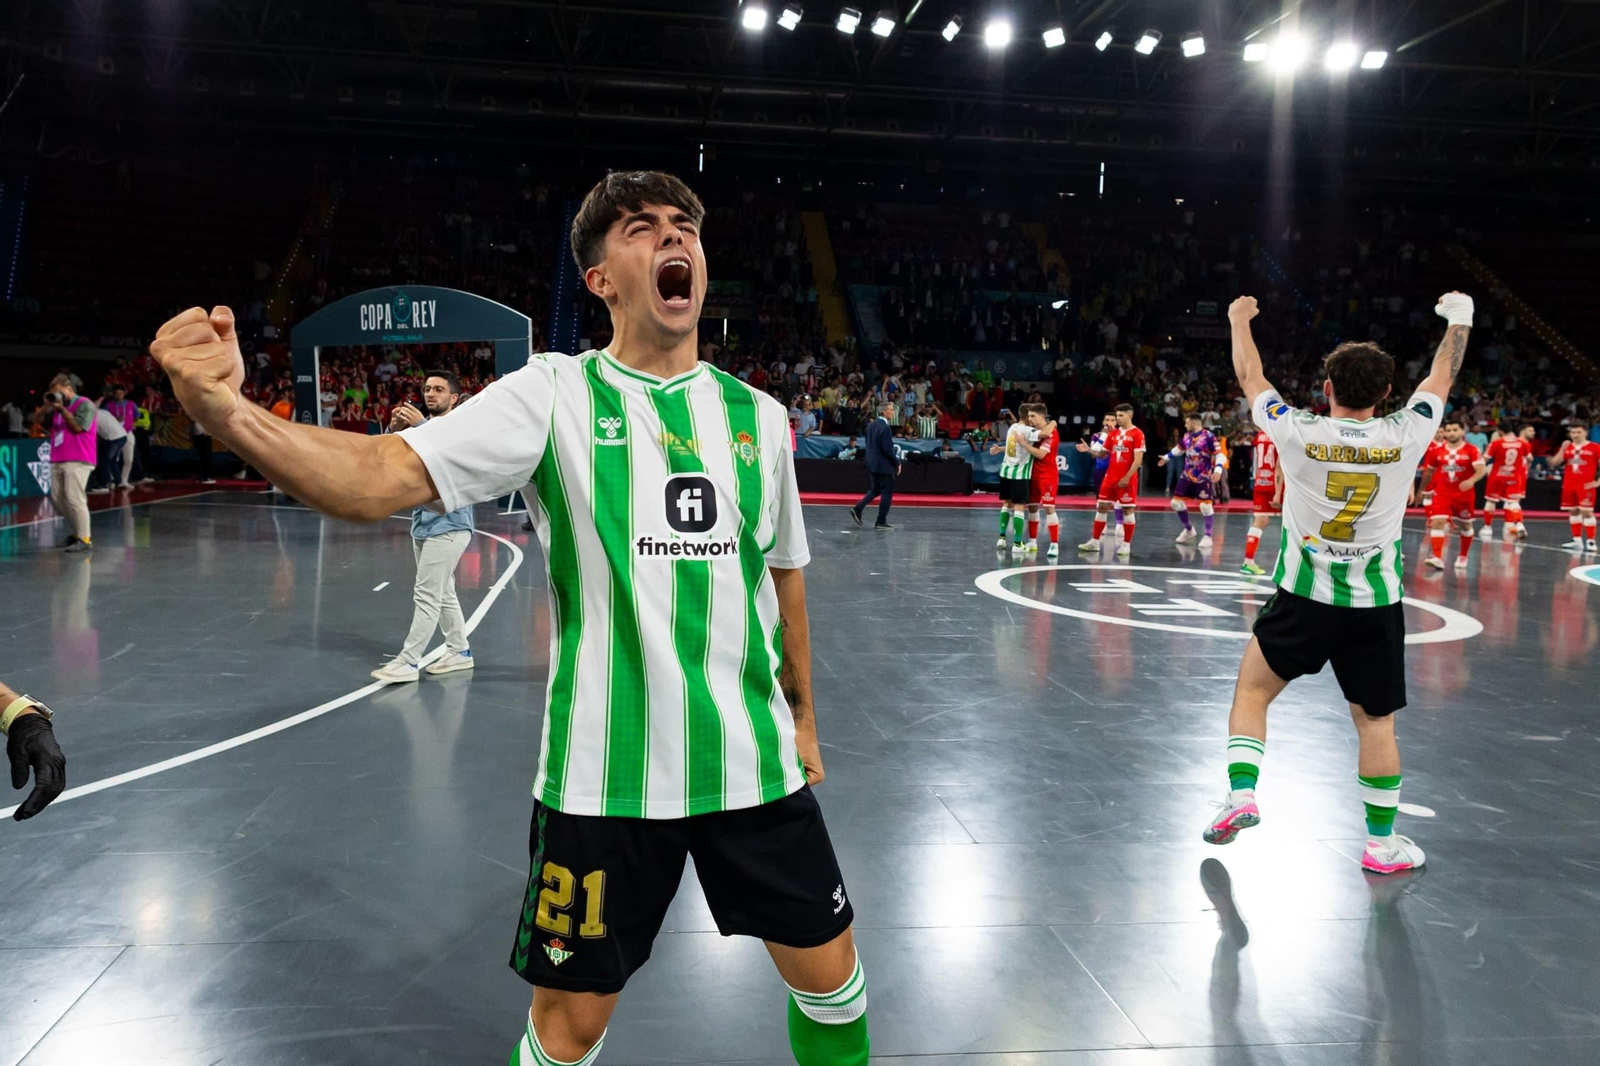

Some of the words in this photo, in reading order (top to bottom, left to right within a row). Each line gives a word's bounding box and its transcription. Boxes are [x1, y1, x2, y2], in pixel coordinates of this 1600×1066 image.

[360, 303, 392, 330] COPA
[412, 300, 436, 328] REY
[595, 436, 627, 446] hummel
[1257, 442, 1275, 469] 14
[1319, 470, 1381, 543] 7
[636, 537, 738, 556] finetwork
[535, 861, 607, 939] 21
